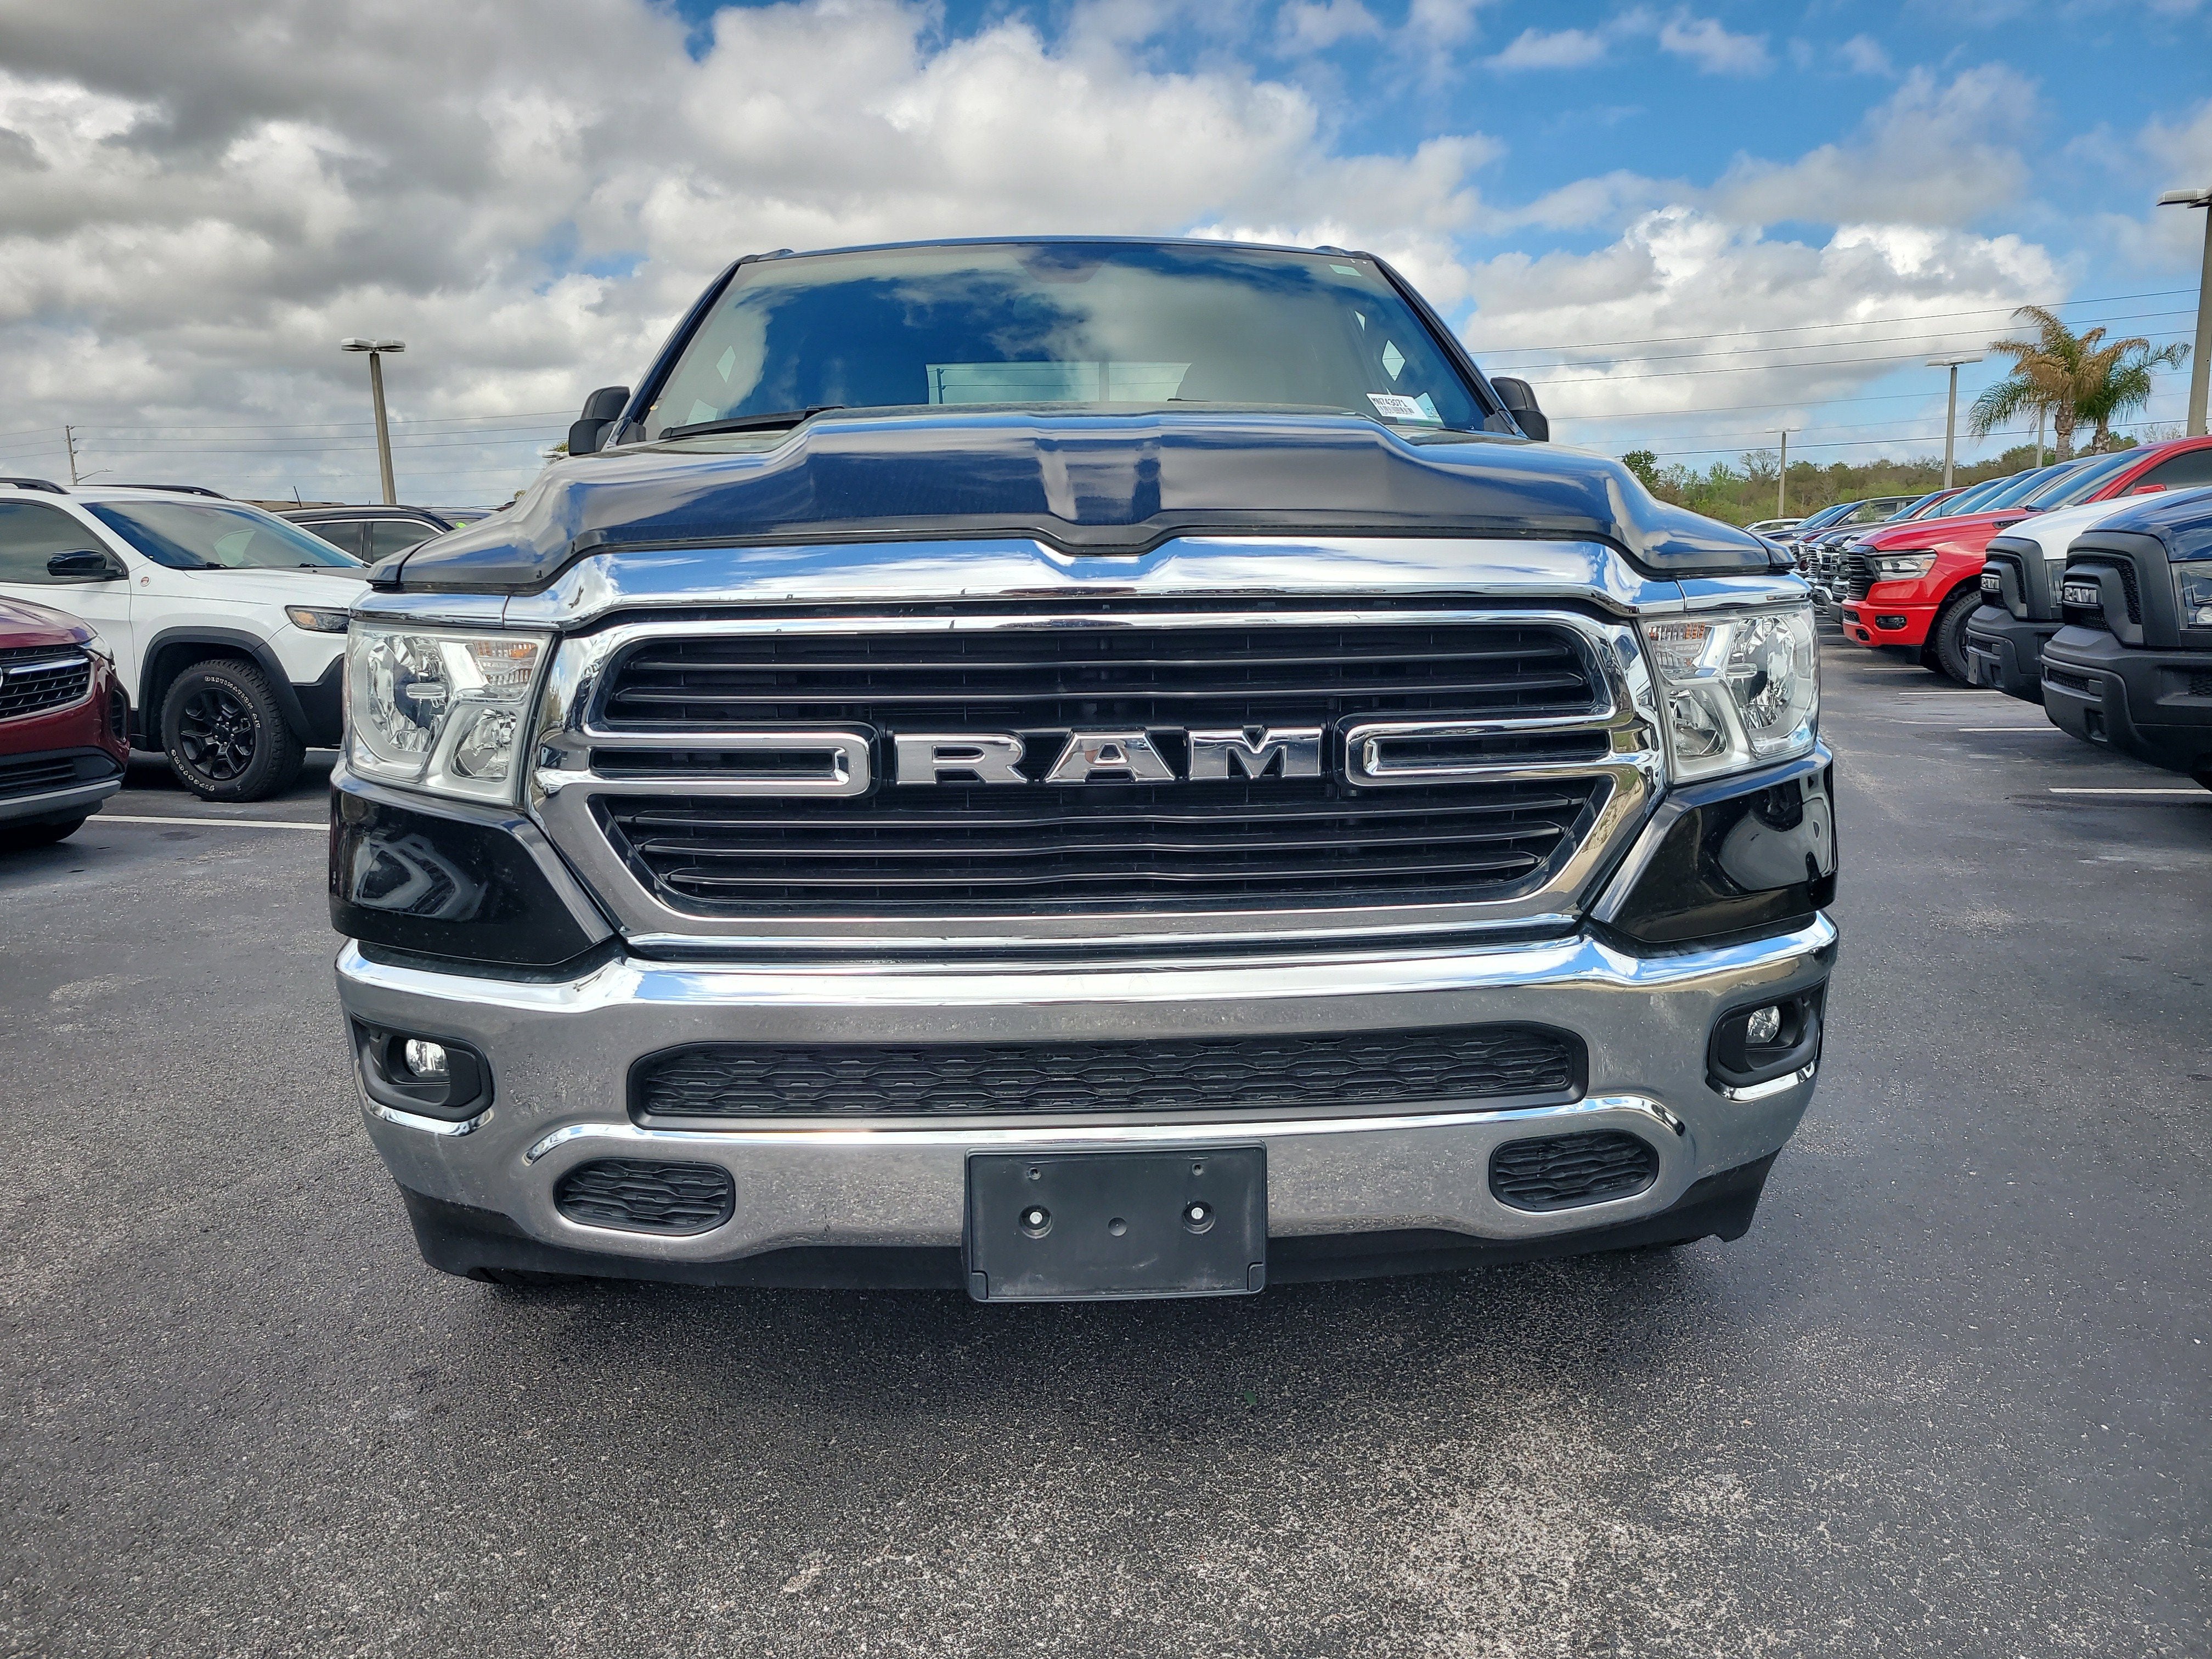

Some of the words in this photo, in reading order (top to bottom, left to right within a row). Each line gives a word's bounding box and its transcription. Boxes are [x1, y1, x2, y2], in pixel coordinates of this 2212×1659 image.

[1981, 577, 2000, 589] RAM
[2064, 586, 2097, 603] RAM
[205, 676, 254, 709] DESTINATION
[252, 713, 261, 729] A/T
[894, 727, 1323, 785] RAM
